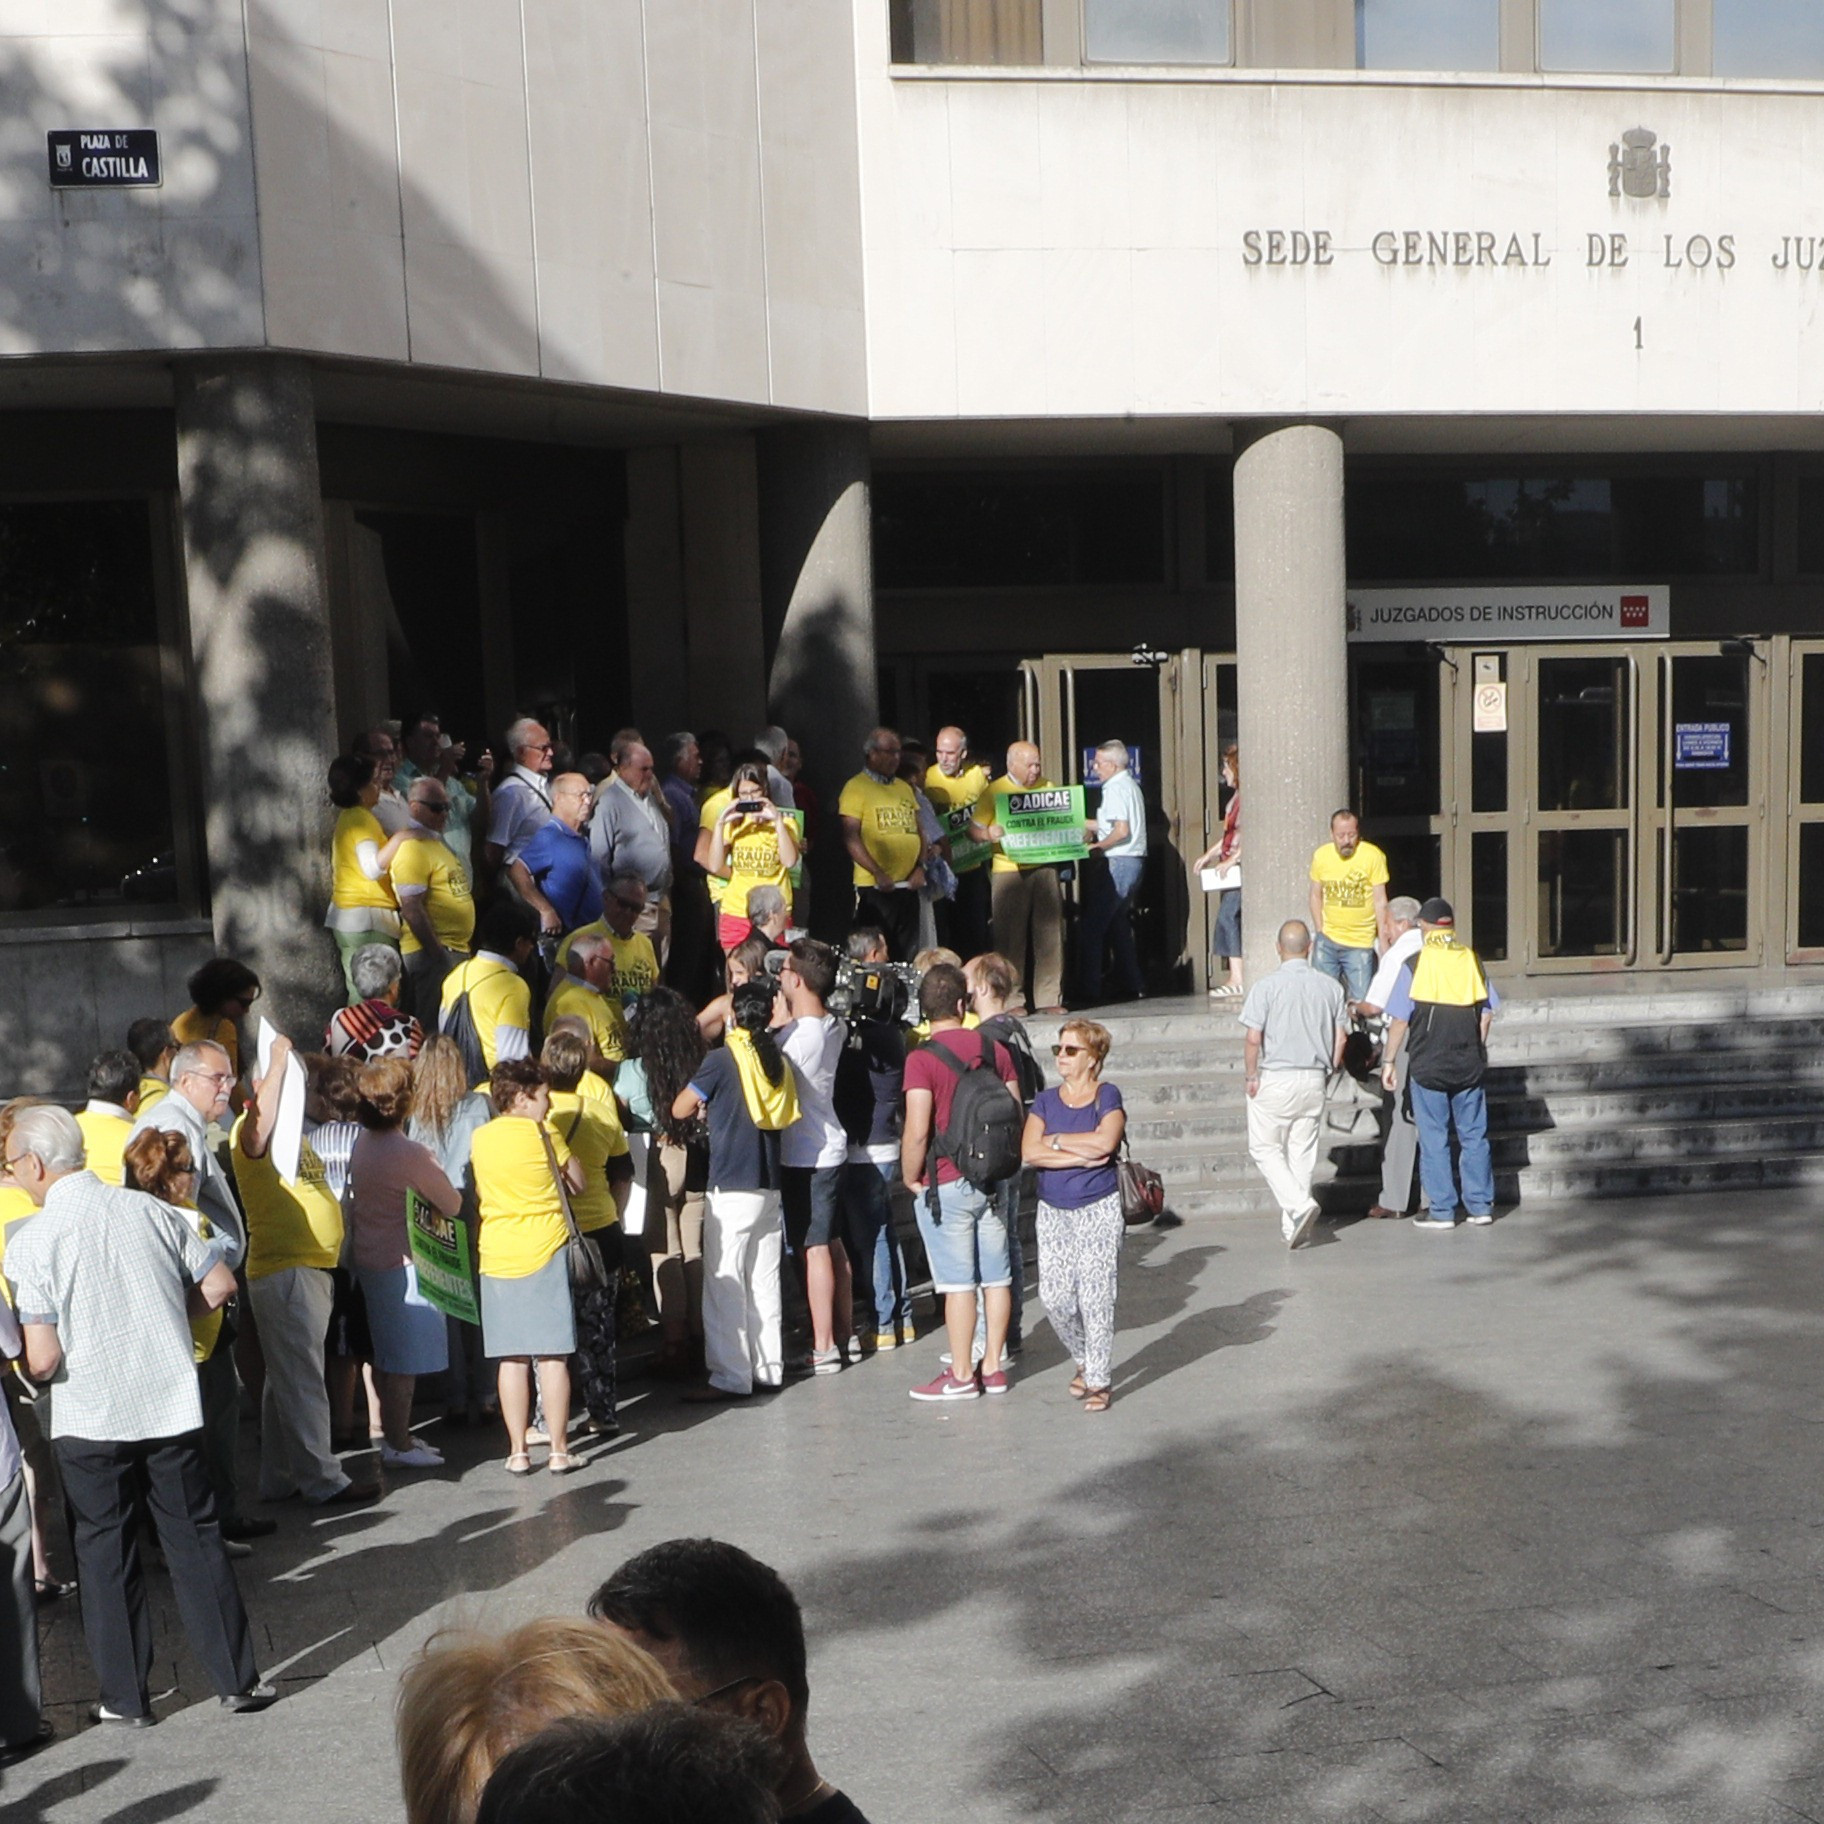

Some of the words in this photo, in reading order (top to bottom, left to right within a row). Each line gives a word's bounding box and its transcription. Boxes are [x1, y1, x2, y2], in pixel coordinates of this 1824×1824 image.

[80, 134, 111, 149] PLAZA
[115, 134, 129, 149] DE
[81, 156, 149, 178] CASTILLA
[1242, 229, 1335, 267] SEDE
[1371, 230, 1552, 267] GENERAL
[1585, 232, 1629, 268] DE
[1663, 233, 1737, 269] LOS
[1370, 605, 1465, 624] JUZGADOS
[1469, 605, 1493, 622] DE
[1497, 600, 1614, 621] INSTRUCCIÓN
[1022, 790, 1070, 809] ADICAE
